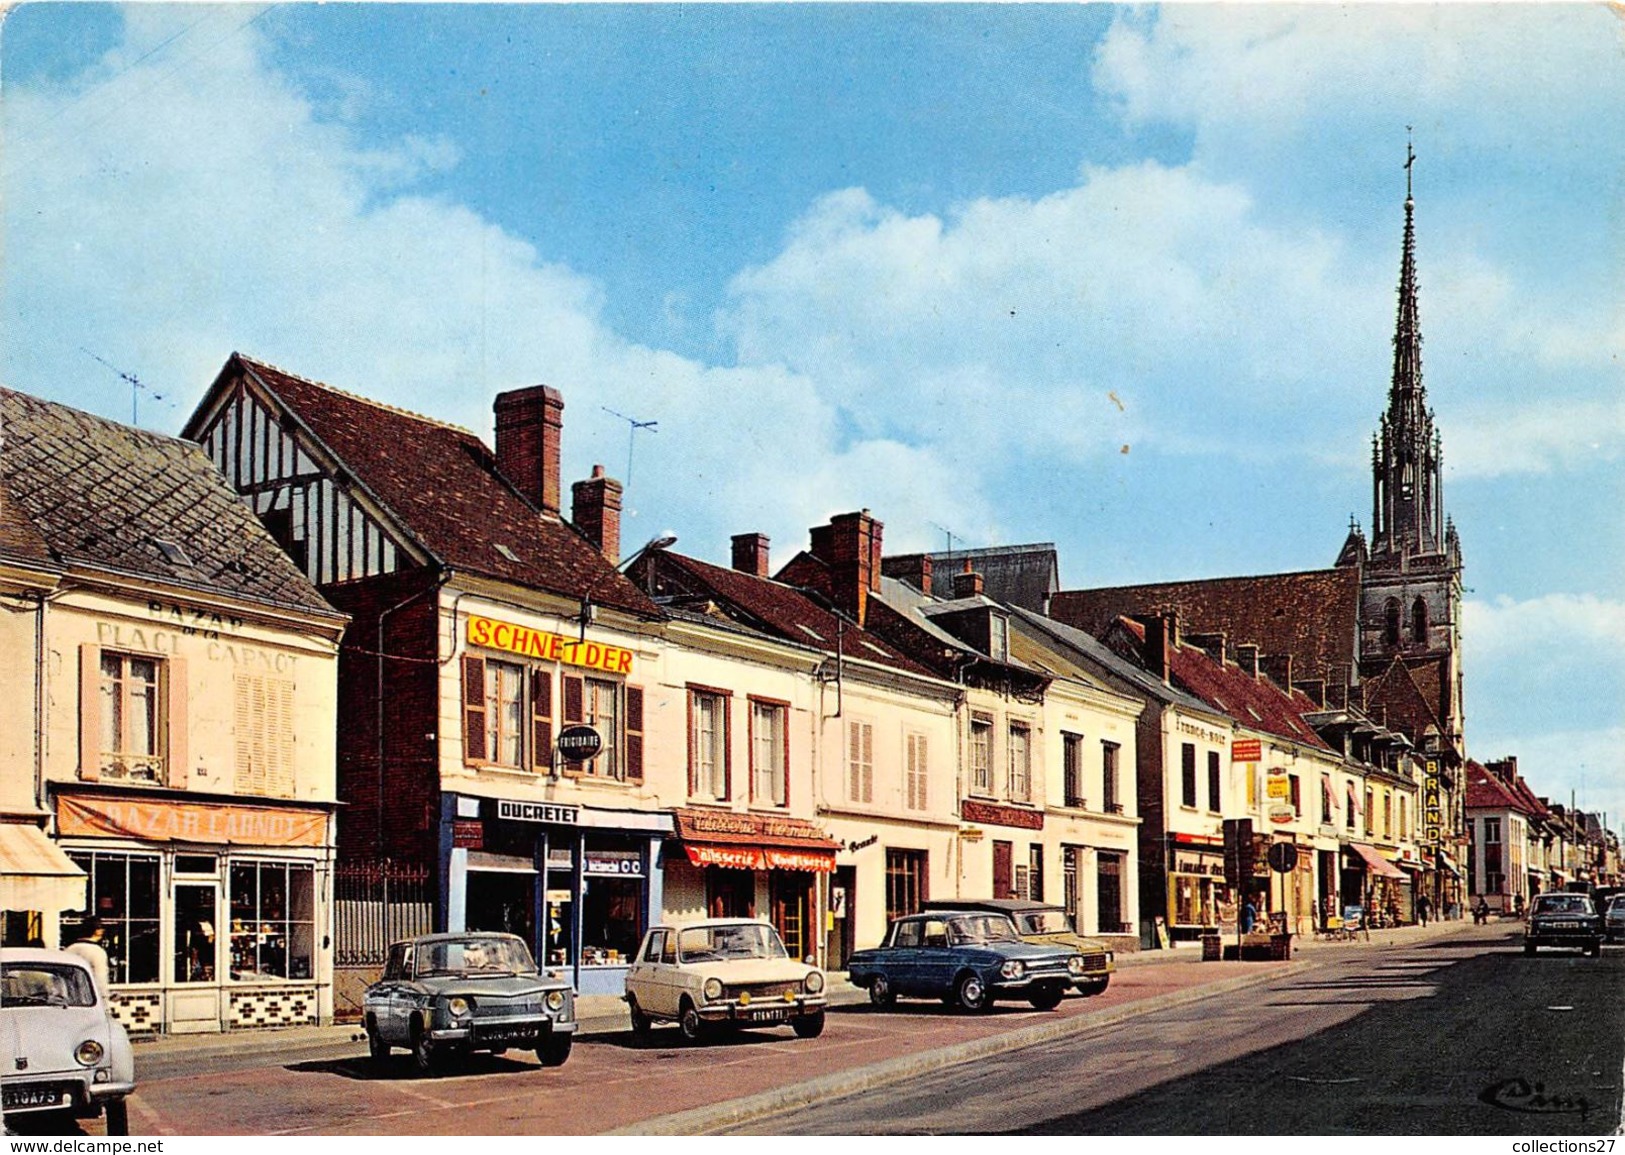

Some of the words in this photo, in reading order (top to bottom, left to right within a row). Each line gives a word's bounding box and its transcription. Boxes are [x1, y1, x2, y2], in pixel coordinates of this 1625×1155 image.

[473, 618, 633, 673] SCHNEIDER
[560, 735, 599, 748] FRIGIDAIRE
[106, 806, 200, 835] BAZAR
[500, 802, 580, 823] DUCRETET
[1426, 761, 1439, 855] BRANDT
